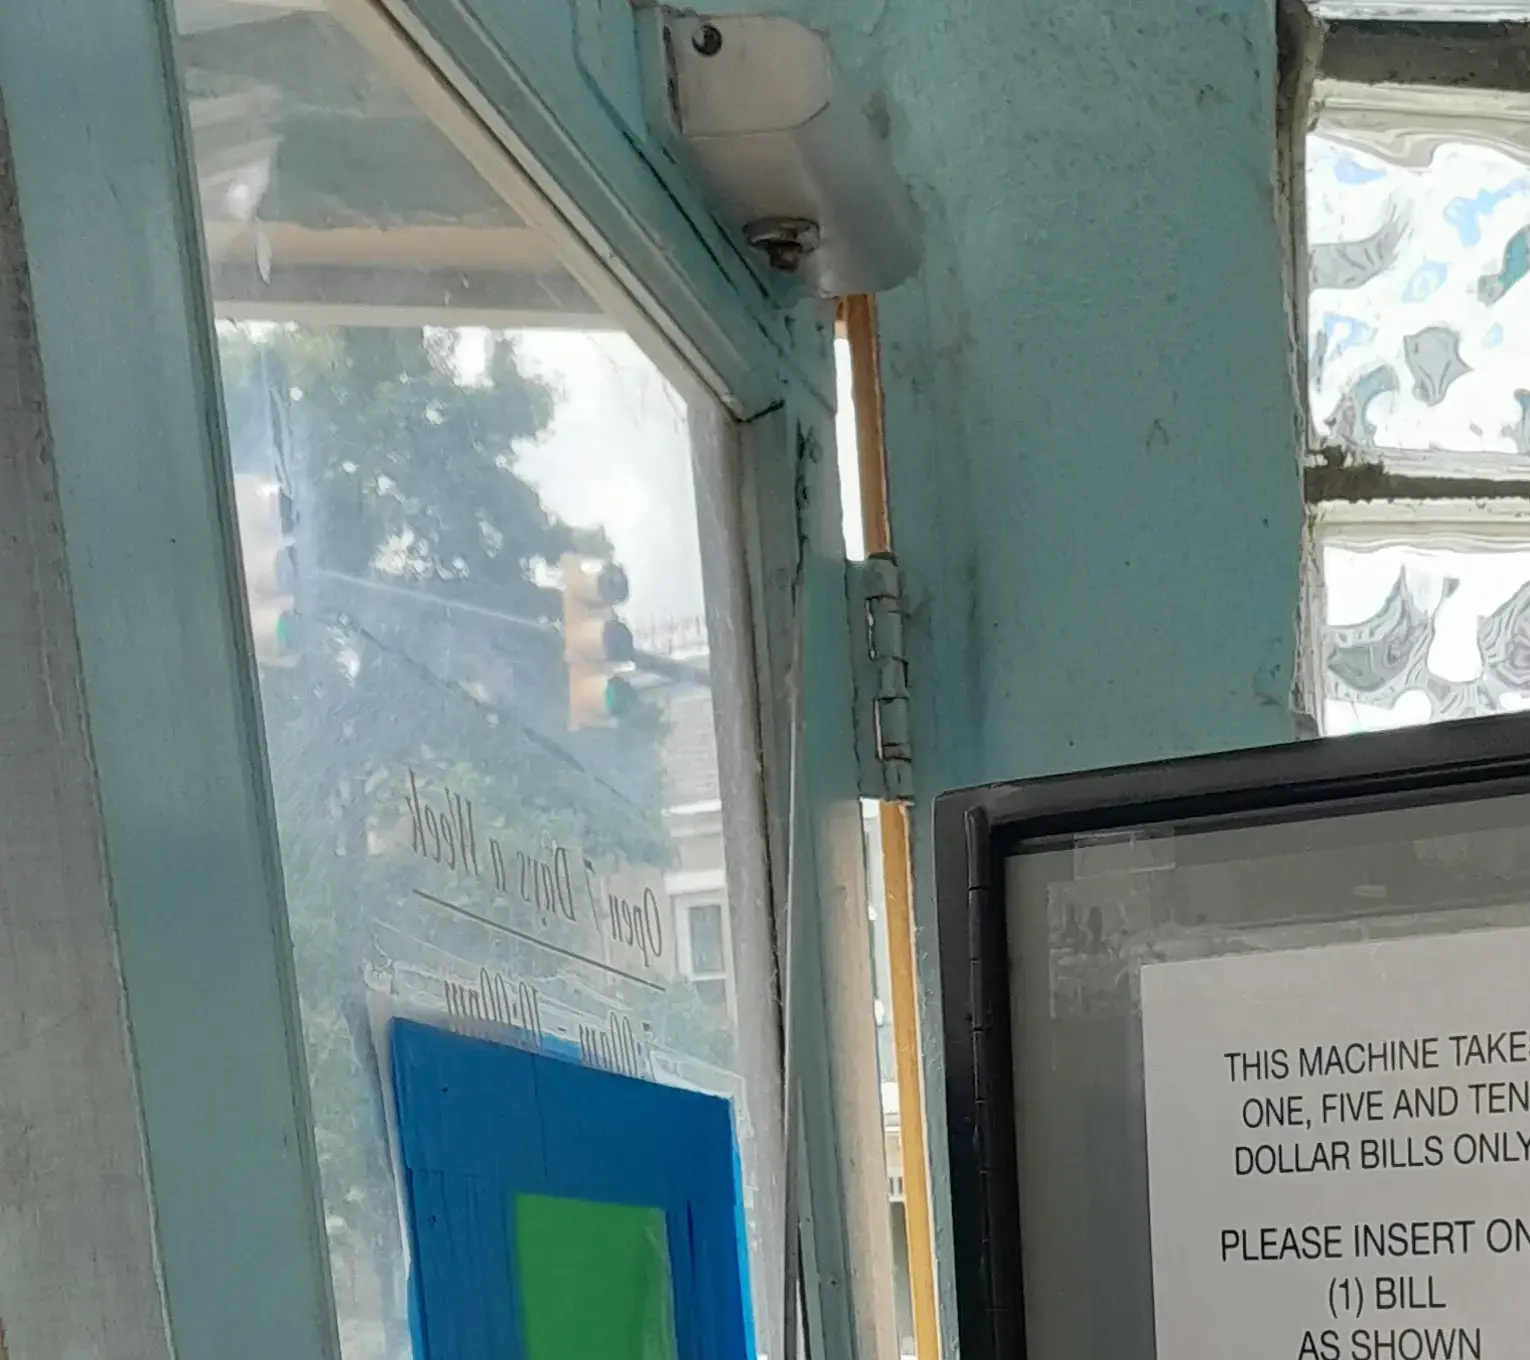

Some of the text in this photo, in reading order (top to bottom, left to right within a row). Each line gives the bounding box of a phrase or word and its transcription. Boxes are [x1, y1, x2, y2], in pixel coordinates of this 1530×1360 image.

[1224, 1049, 1288, 1081] THIS
[1300, 1038, 1439, 1077] MACHINE
[1243, 1081, 1528, 1129] ONE, FIVE AND TEN
[1236, 1141, 1349, 1175] DOLLAR
[1361, 1136, 1443, 1169] BILLS
[1222, 1226, 1342, 1261] PLEASE
[1355, 1220, 1475, 1257] INSERT
[1329, 1276, 1446, 1318] (1) BILL
